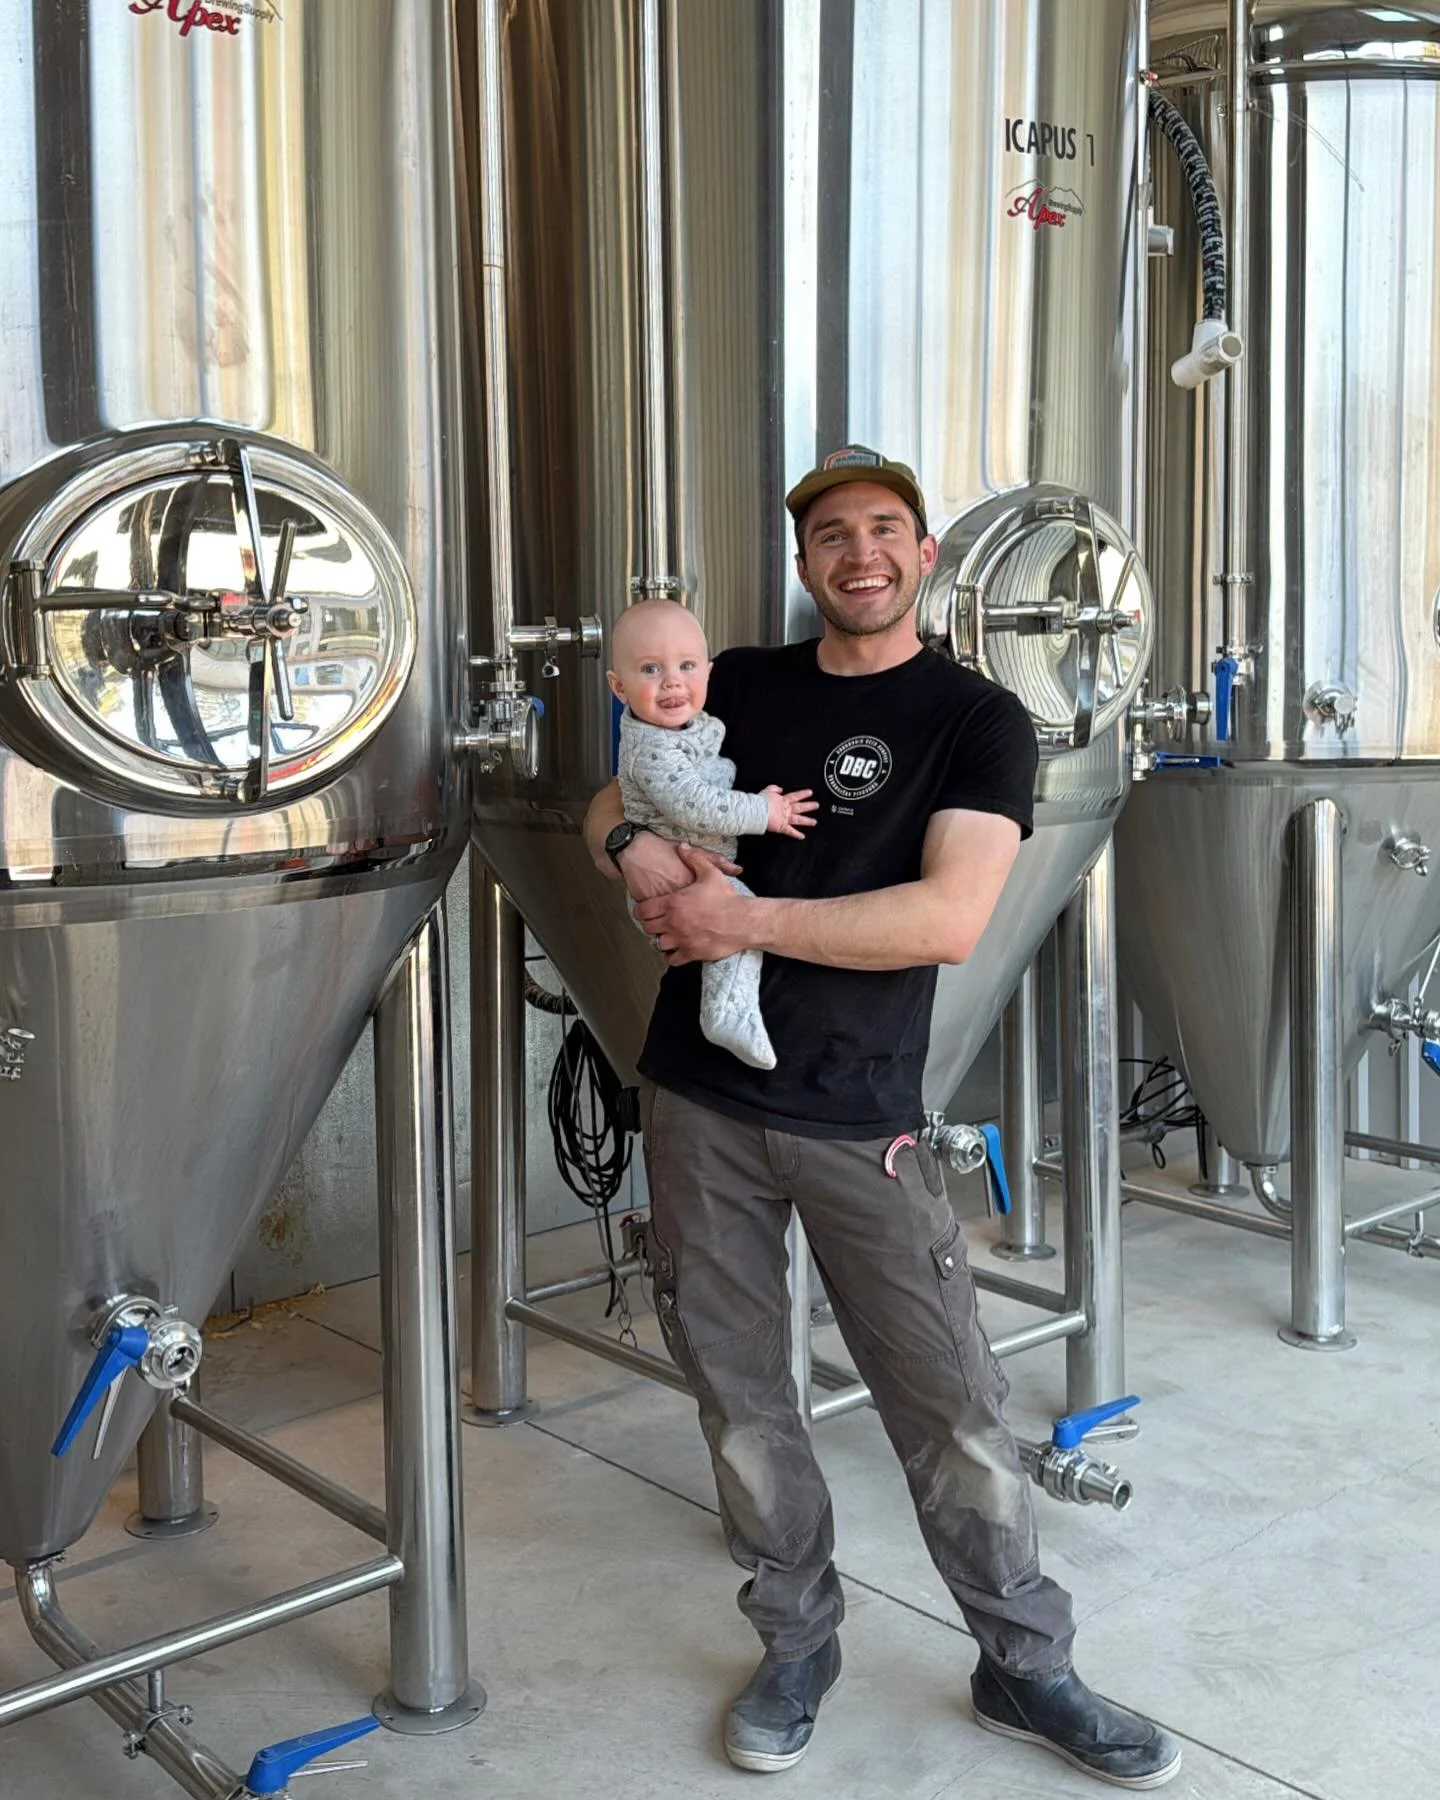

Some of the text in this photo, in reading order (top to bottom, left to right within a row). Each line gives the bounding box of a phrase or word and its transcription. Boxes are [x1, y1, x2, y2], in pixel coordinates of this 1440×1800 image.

[1086, 133, 1095, 167] 1
[1007, 187, 1066, 231] Apex
[840, 755, 877, 779] DBC
